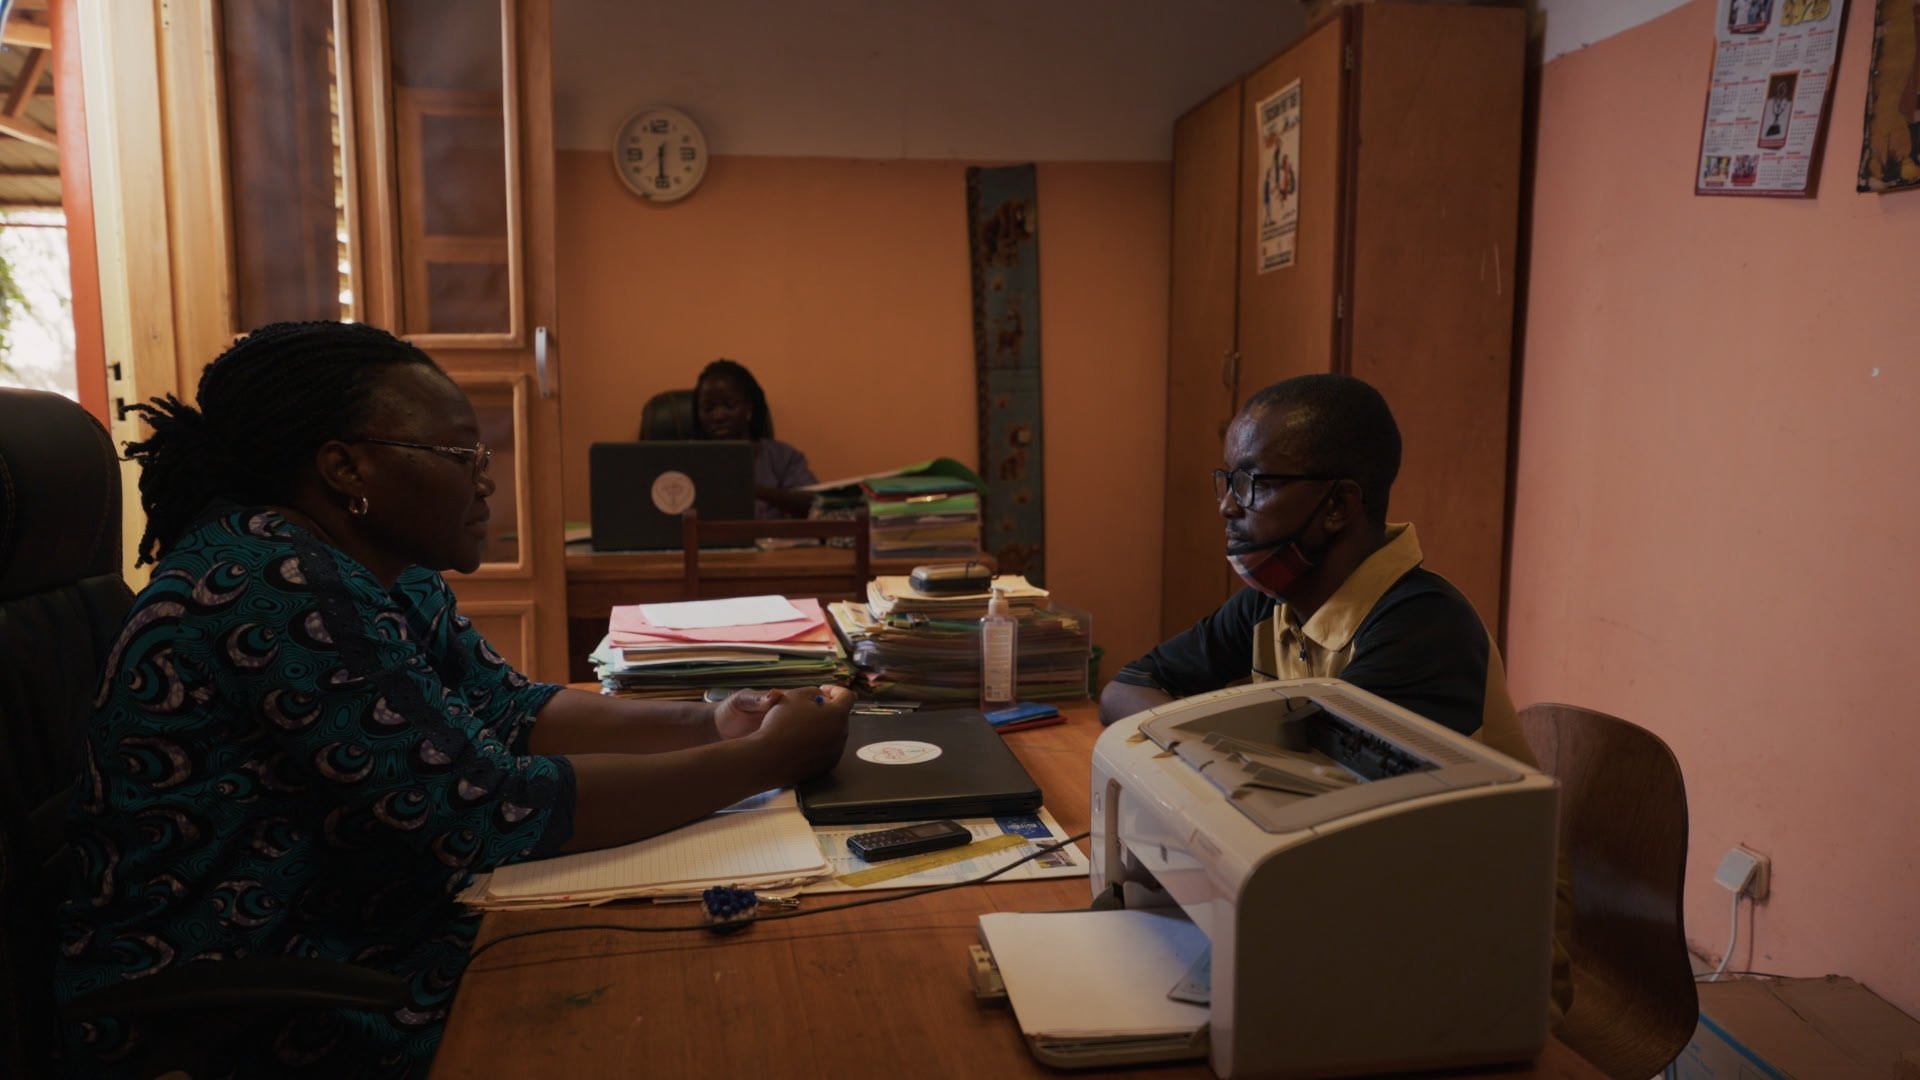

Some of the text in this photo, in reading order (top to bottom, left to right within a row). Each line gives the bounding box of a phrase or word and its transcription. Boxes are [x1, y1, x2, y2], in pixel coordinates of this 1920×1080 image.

[650, 119, 669, 133] 12
[627, 147, 642, 161] 9
[680, 146, 695, 161] 3
